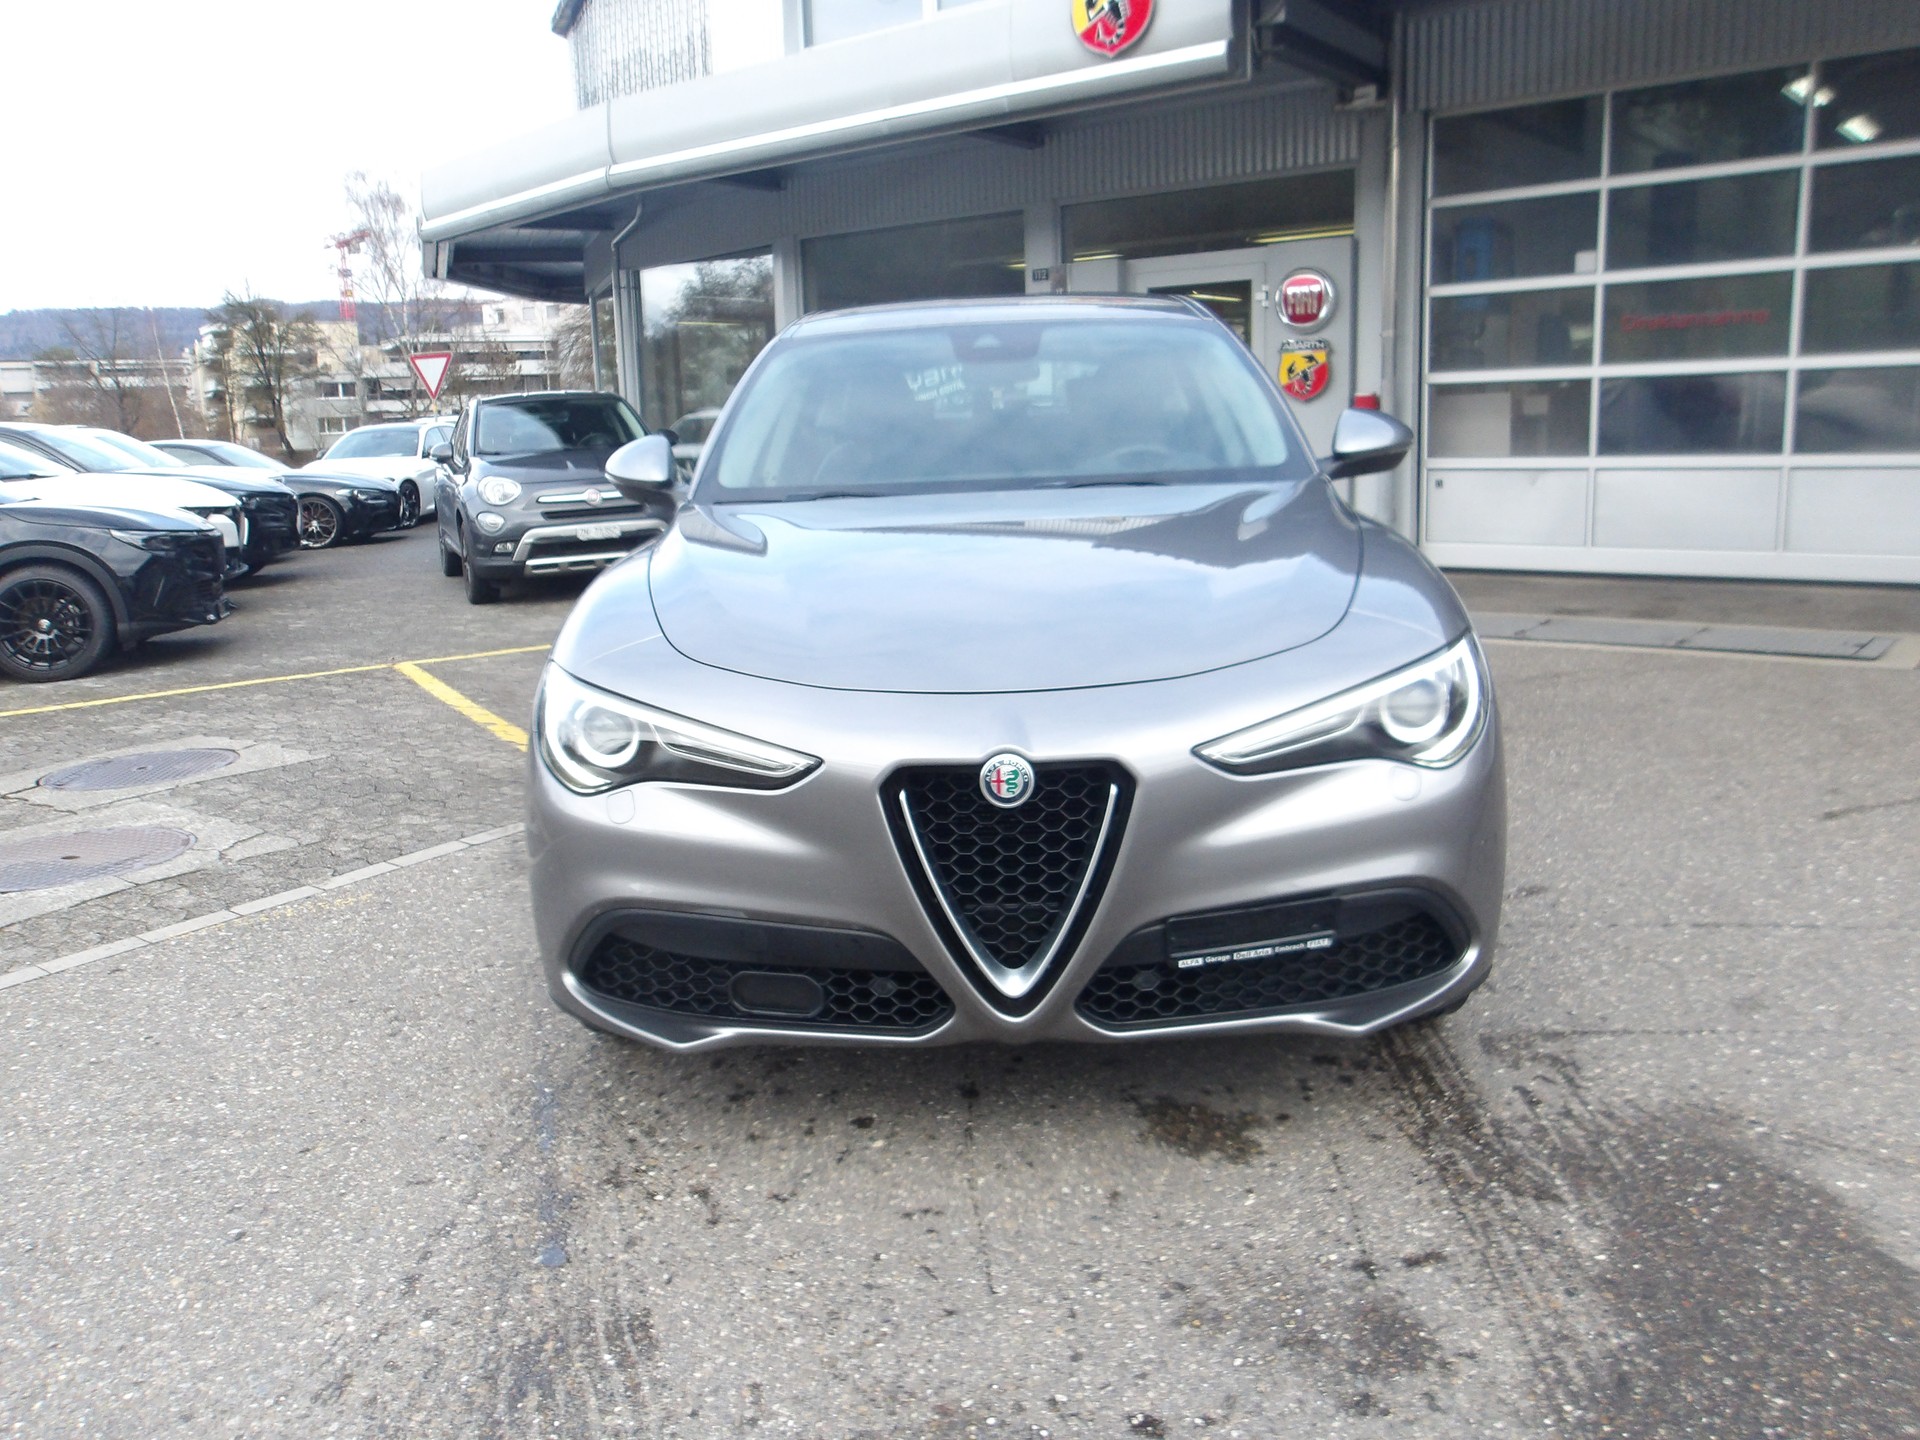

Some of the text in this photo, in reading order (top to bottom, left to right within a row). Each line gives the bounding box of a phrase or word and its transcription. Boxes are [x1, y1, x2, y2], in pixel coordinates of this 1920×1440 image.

[1286, 284, 1322, 315] FIAT
[1205, 954, 1231, 963] Garage
[1274, 942, 1305, 953] Embrach
